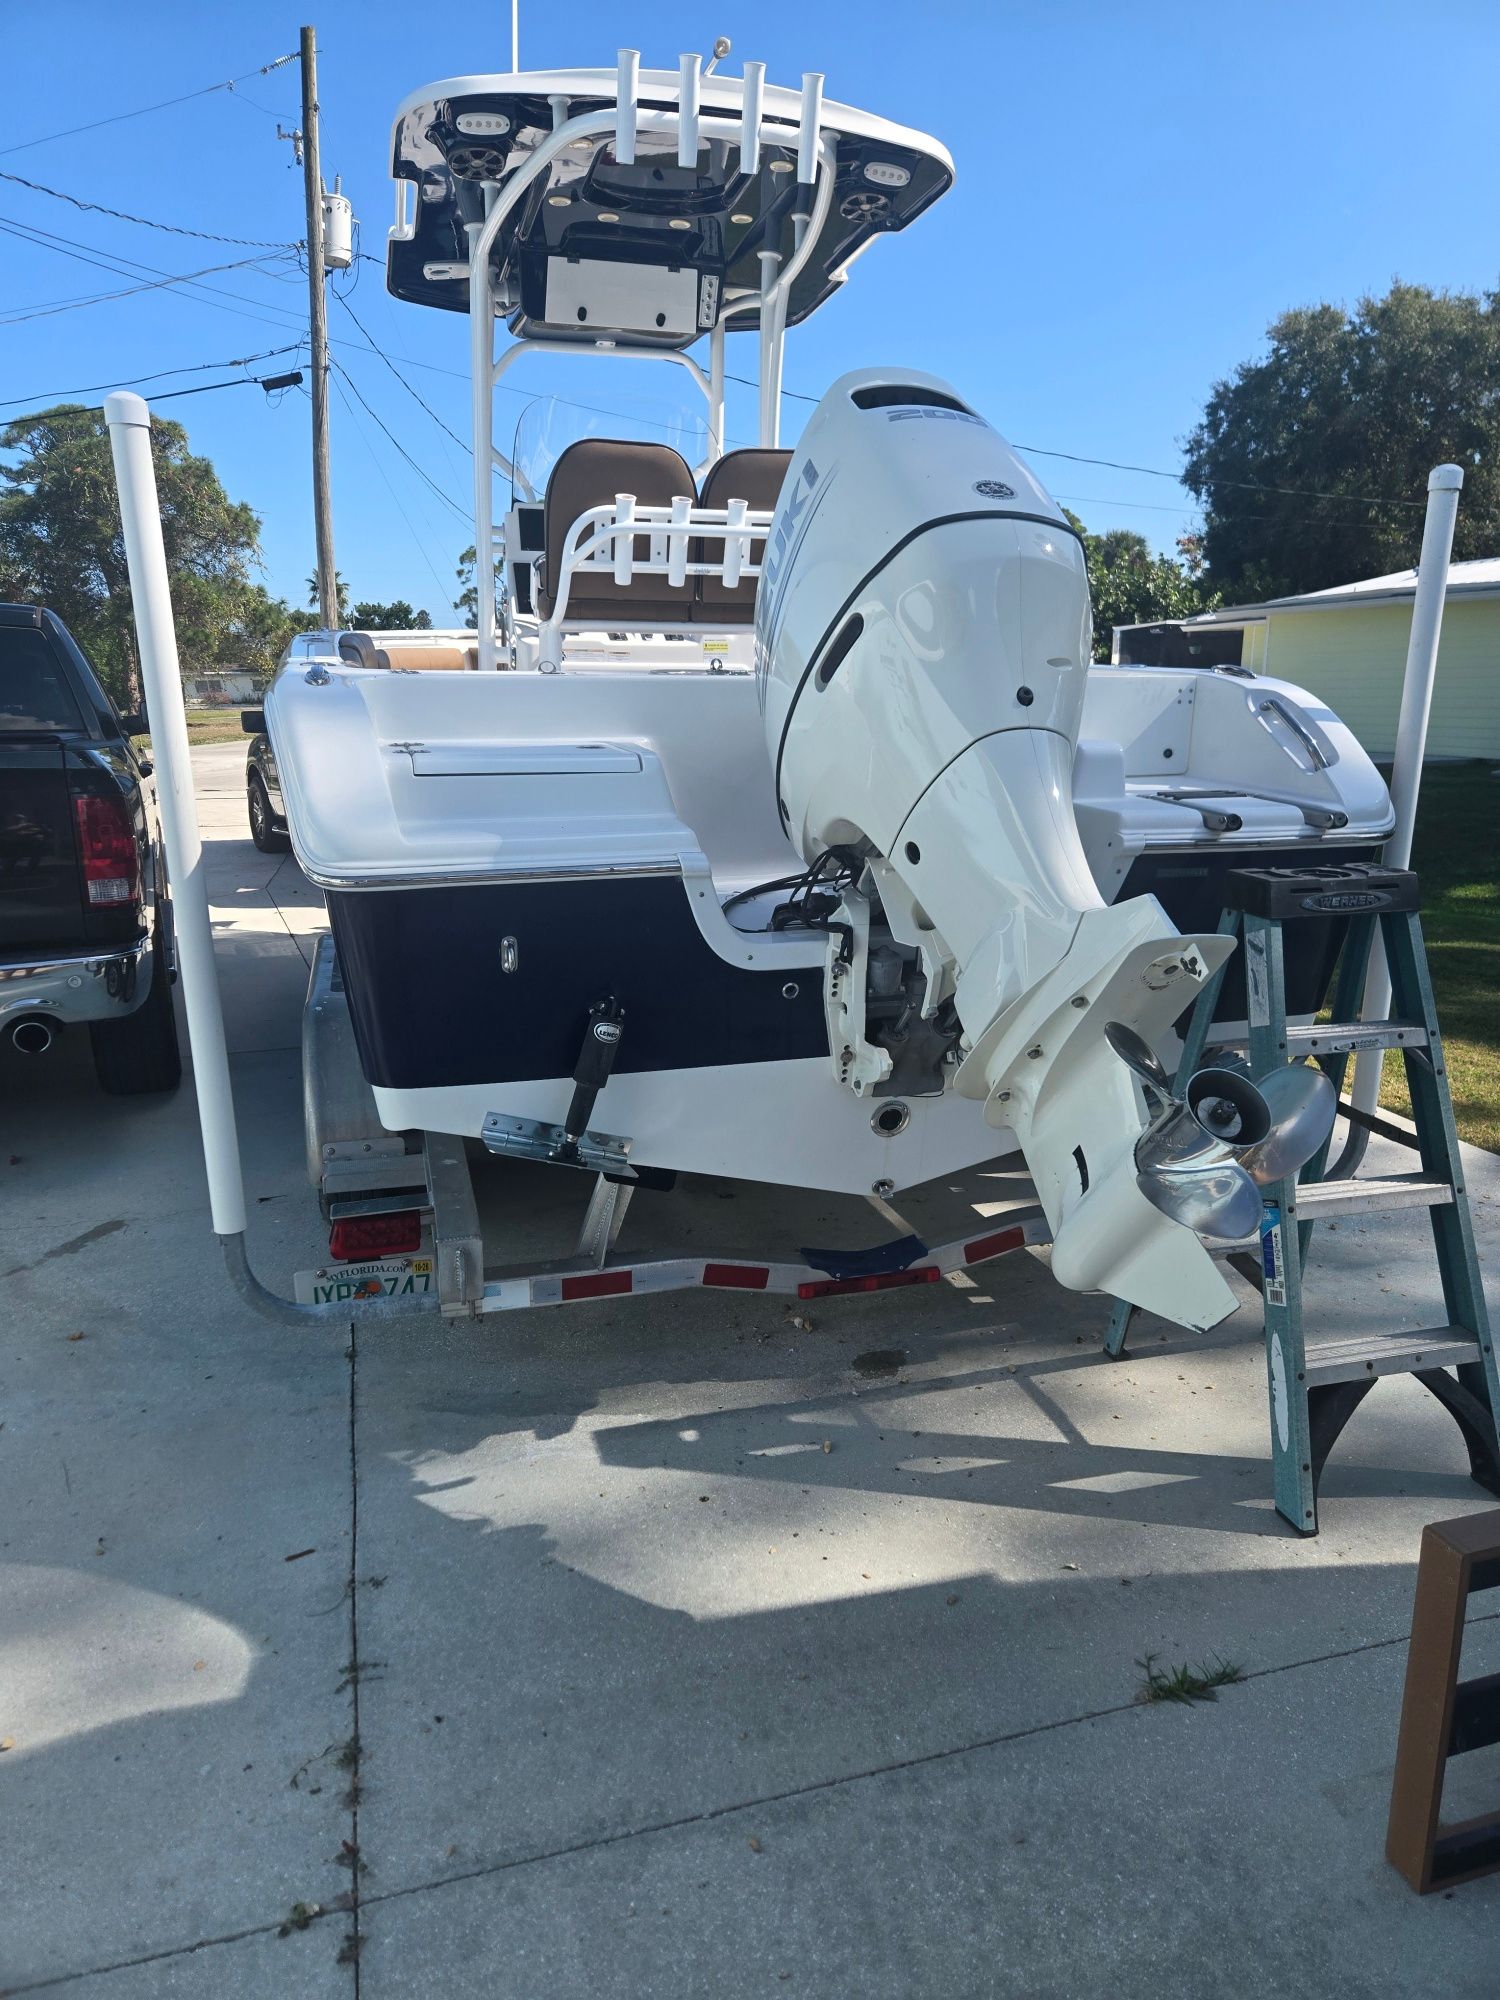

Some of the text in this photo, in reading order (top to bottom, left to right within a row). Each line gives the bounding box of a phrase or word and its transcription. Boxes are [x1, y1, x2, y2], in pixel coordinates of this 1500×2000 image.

[886, 408, 988, 428] 200
[1319, 894, 1376, 908] WERNER
[325, 1265, 407, 1283] MYFLORIDA.COM
